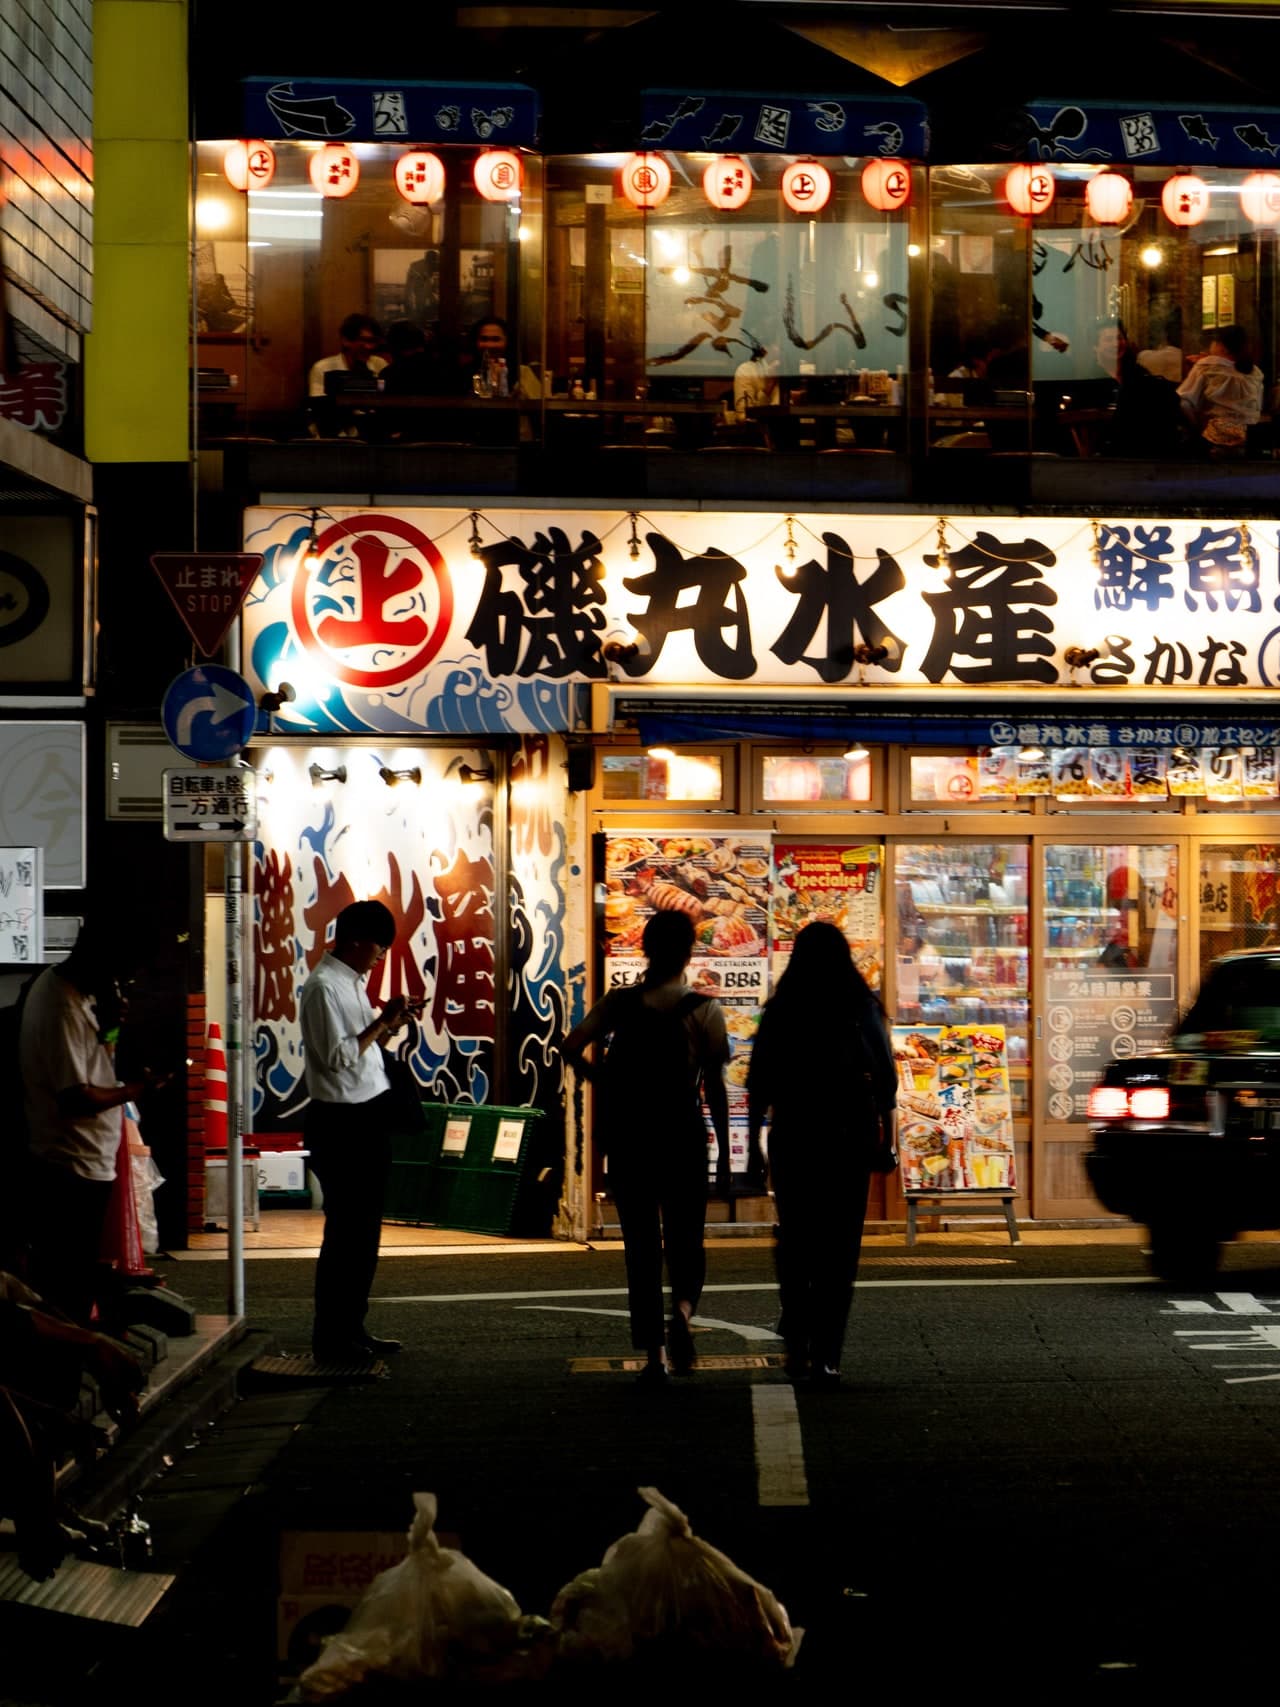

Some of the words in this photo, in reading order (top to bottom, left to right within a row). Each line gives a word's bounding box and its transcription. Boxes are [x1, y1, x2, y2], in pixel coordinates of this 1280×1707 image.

[175, 565, 243, 589] 止まれ
[186, 594, 233, 613] STOP
[465, 526, 1059, 684] 磯丸水産
[1017, 724, 1111, 745] 磯丸水産
[170, 775, 248, 795] 自転車を除く
[170, 798, 250, 816] 一方通行
[1068, 981, 1153, 997] 24時間営業
